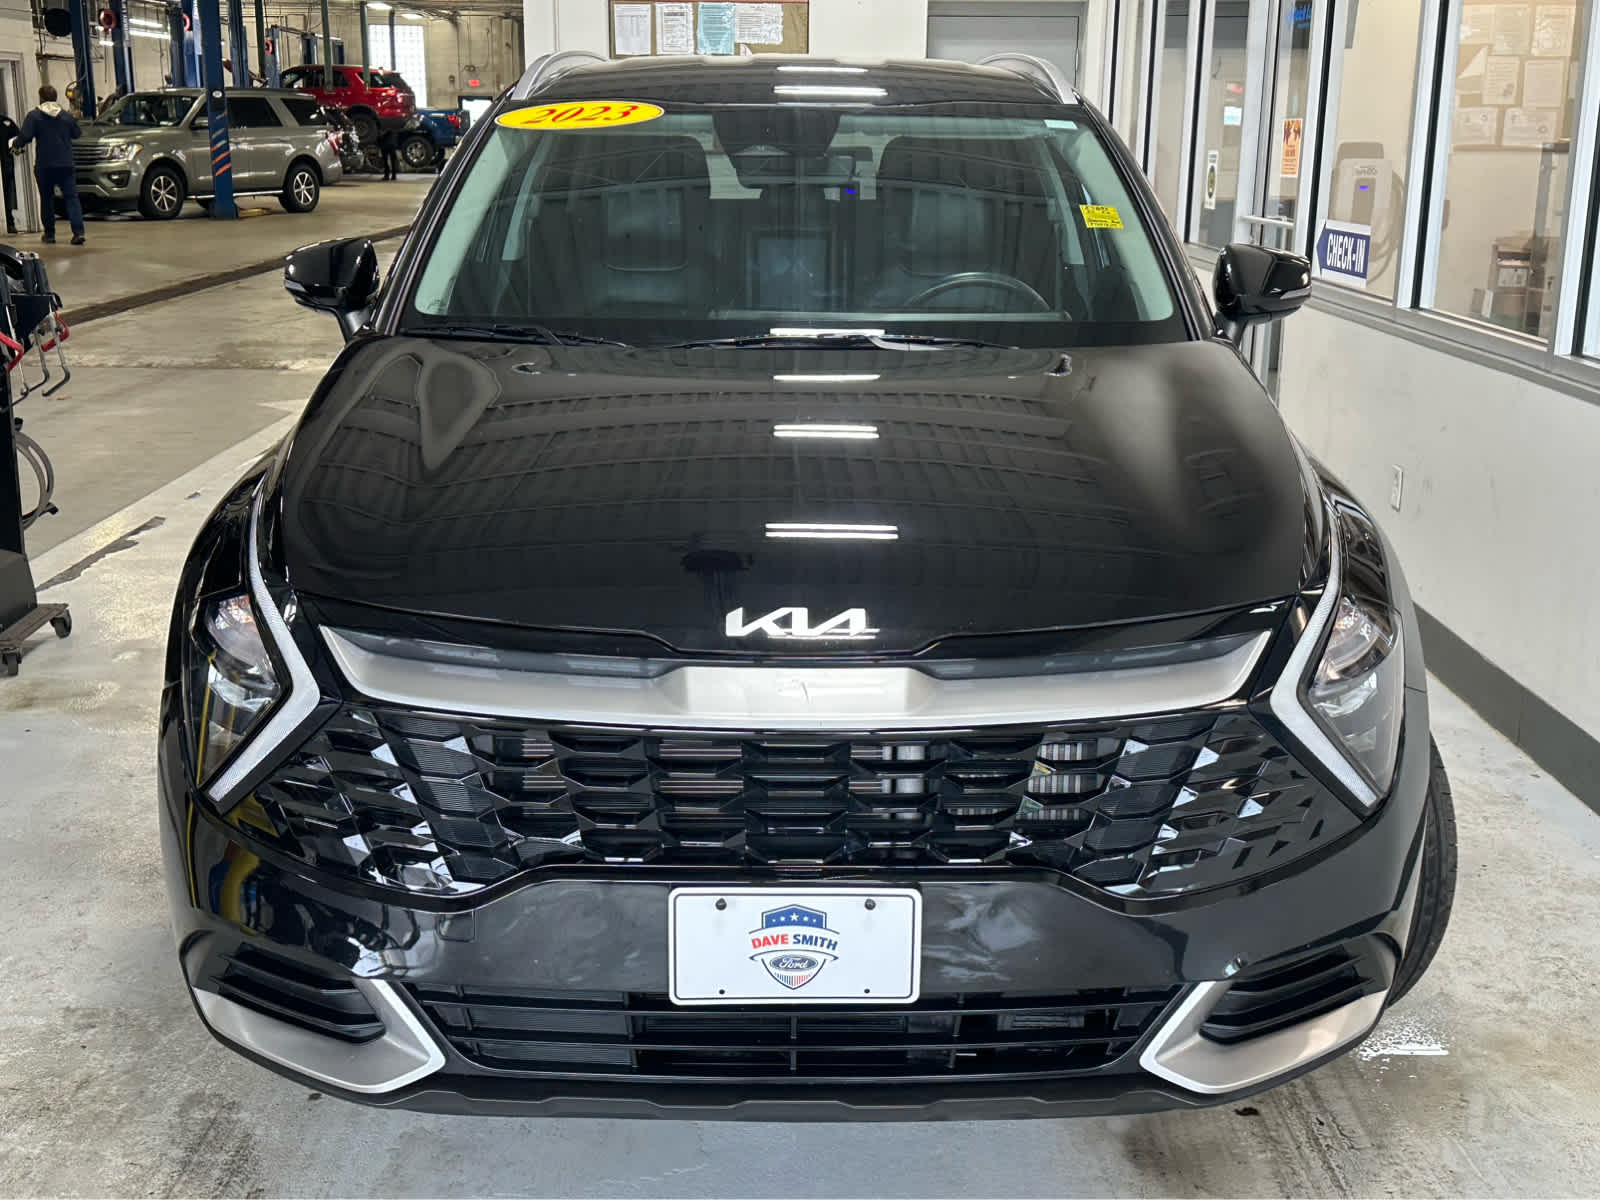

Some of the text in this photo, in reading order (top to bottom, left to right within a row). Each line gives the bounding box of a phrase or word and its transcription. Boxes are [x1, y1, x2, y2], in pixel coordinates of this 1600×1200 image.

[521, 105, 638, 125] 2023
[1326, 232, 1366, 273] CHECK-IN
[725, 606, 872, 639] KIA
[751, 933, 838, 951] DAVE SMITH
[778, 955, 809, 969] Ford
